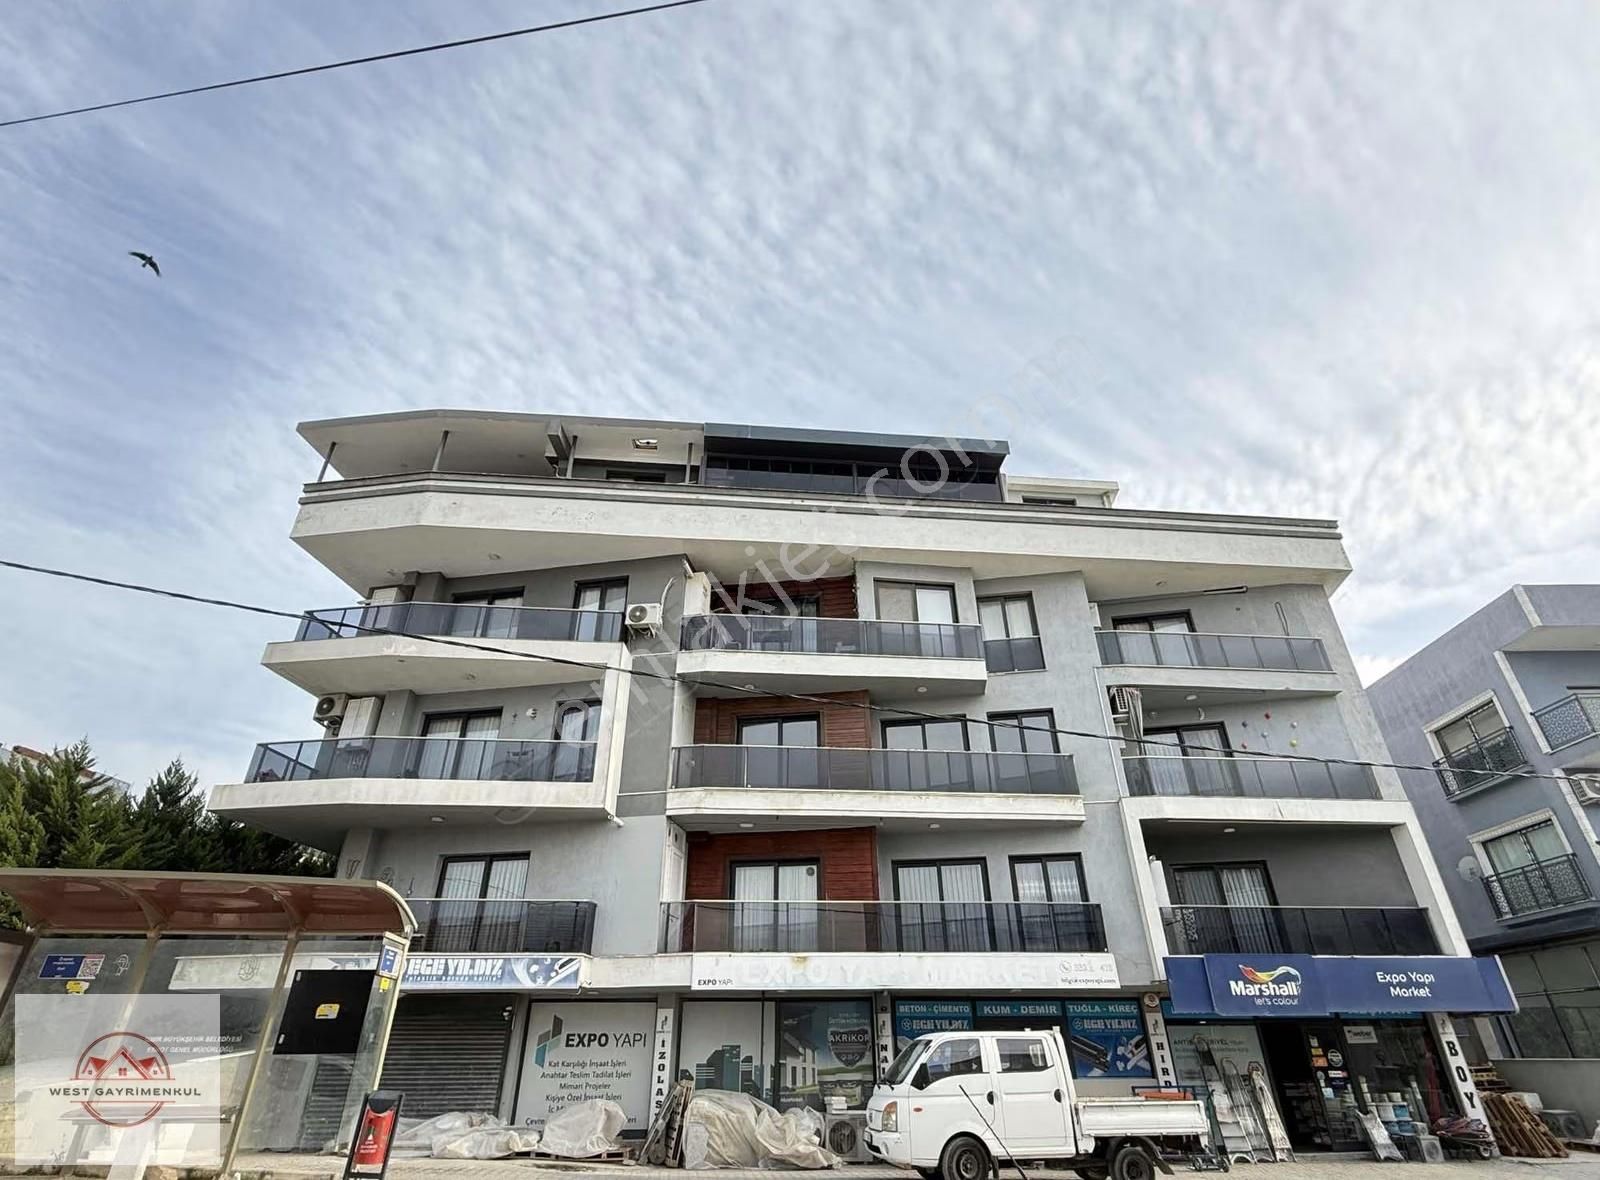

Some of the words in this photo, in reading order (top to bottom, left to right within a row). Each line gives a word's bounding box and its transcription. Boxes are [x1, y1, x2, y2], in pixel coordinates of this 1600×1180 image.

[1376, 972, 1407, 984] Expo
[1408, 972, 1435, 984] Yapı
[1229, 981, 1298, 996] Marshall
[1390, 986, 1432, 998] Market
[899, 1004, 927, 1013] BETON
[933, 1004, 970, 1014] ÇİMENTO
[983, 1005, 1011, 1014] KUM
[1021, 1004, 1057, 1014] DEMİR
[1068, 1003, 1101, 1013] TUĞLA
[1108, 1004, 1138, 1014] KİREÇ
[565, 1032, 609, 1048] EXPO
[613, 1032, 647, 1048] YAPI
[548, 1060, 560, 1068] Kat
[540, 1070, 568, 1079] Anahtar
[569, 1070, 591, 1079] Teslim
[592, 1070, 614, 1079] Tadilat
[559, 1082, 583, 1090] Mimari
[585, 1082, 611, 1092] Projeler
